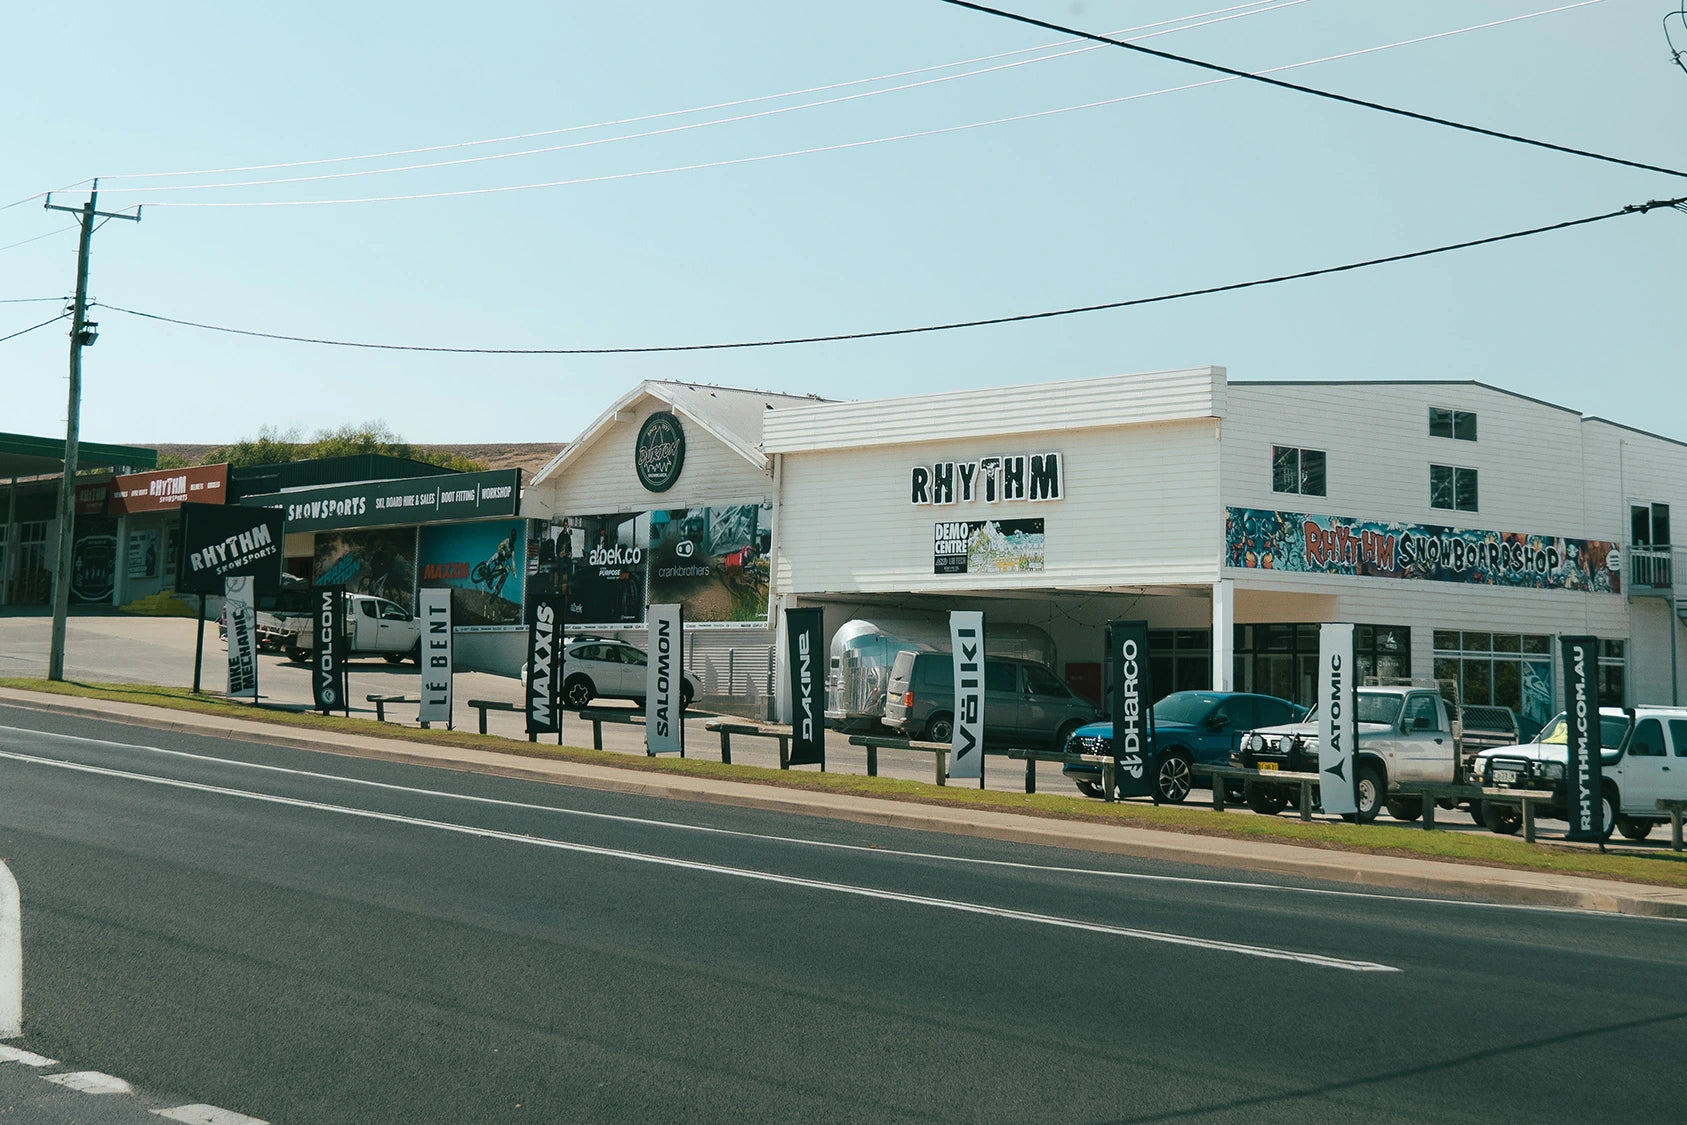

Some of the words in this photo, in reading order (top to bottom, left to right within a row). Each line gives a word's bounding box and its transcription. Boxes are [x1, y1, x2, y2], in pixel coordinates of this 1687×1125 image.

[638, 438, 680, 465] BURTON
[150, 476, 187, 496] RHYTHM
[160, 494, 188, 503] SNOWSPORTS
[386, 496, 402, 508] BOARD
[403, 495, 414, 507] HIRE
[415, 495, 419, 506] &
[420, 493, 436, 505] SALES
[441, 491, 455, 503] BOOT
[456, 490, 475, 502] FITTING
[481, 486, 512, 500] WORKSHOP
[911, 453, 1062, 504] RHYTHM
[288, 496, 366, 521] SNOWSPORTS
[190, 523, 272, 572] RHYTHM
[935, 539, 967, 554] CENTRE
[936, 522, 968, 540] DEMO
[1304, 520, 1395, 571] RHYTHM
[216, 544, 277, 576] SNOWSPORTS
[424, 562, 470, 580] MAXXIS
[658, 565, 710, 577] crankbrothers
[233, 609, 255, 690] MECHANIC
[322, 592, 333, 688] VOLCOM
[429, 605, 448, 668] BENT
[228, 656, 243, 694] BIKE
[532, 604, 555, 726] MAXXIS
[657, 620, 670, 737] SALOMON
[798, 630, 813, 743] DAKINE
[1330, 654, 1342, 753] ATOMIC
[1573, 646, 1591, 831] RHYTHM.COM.AU
